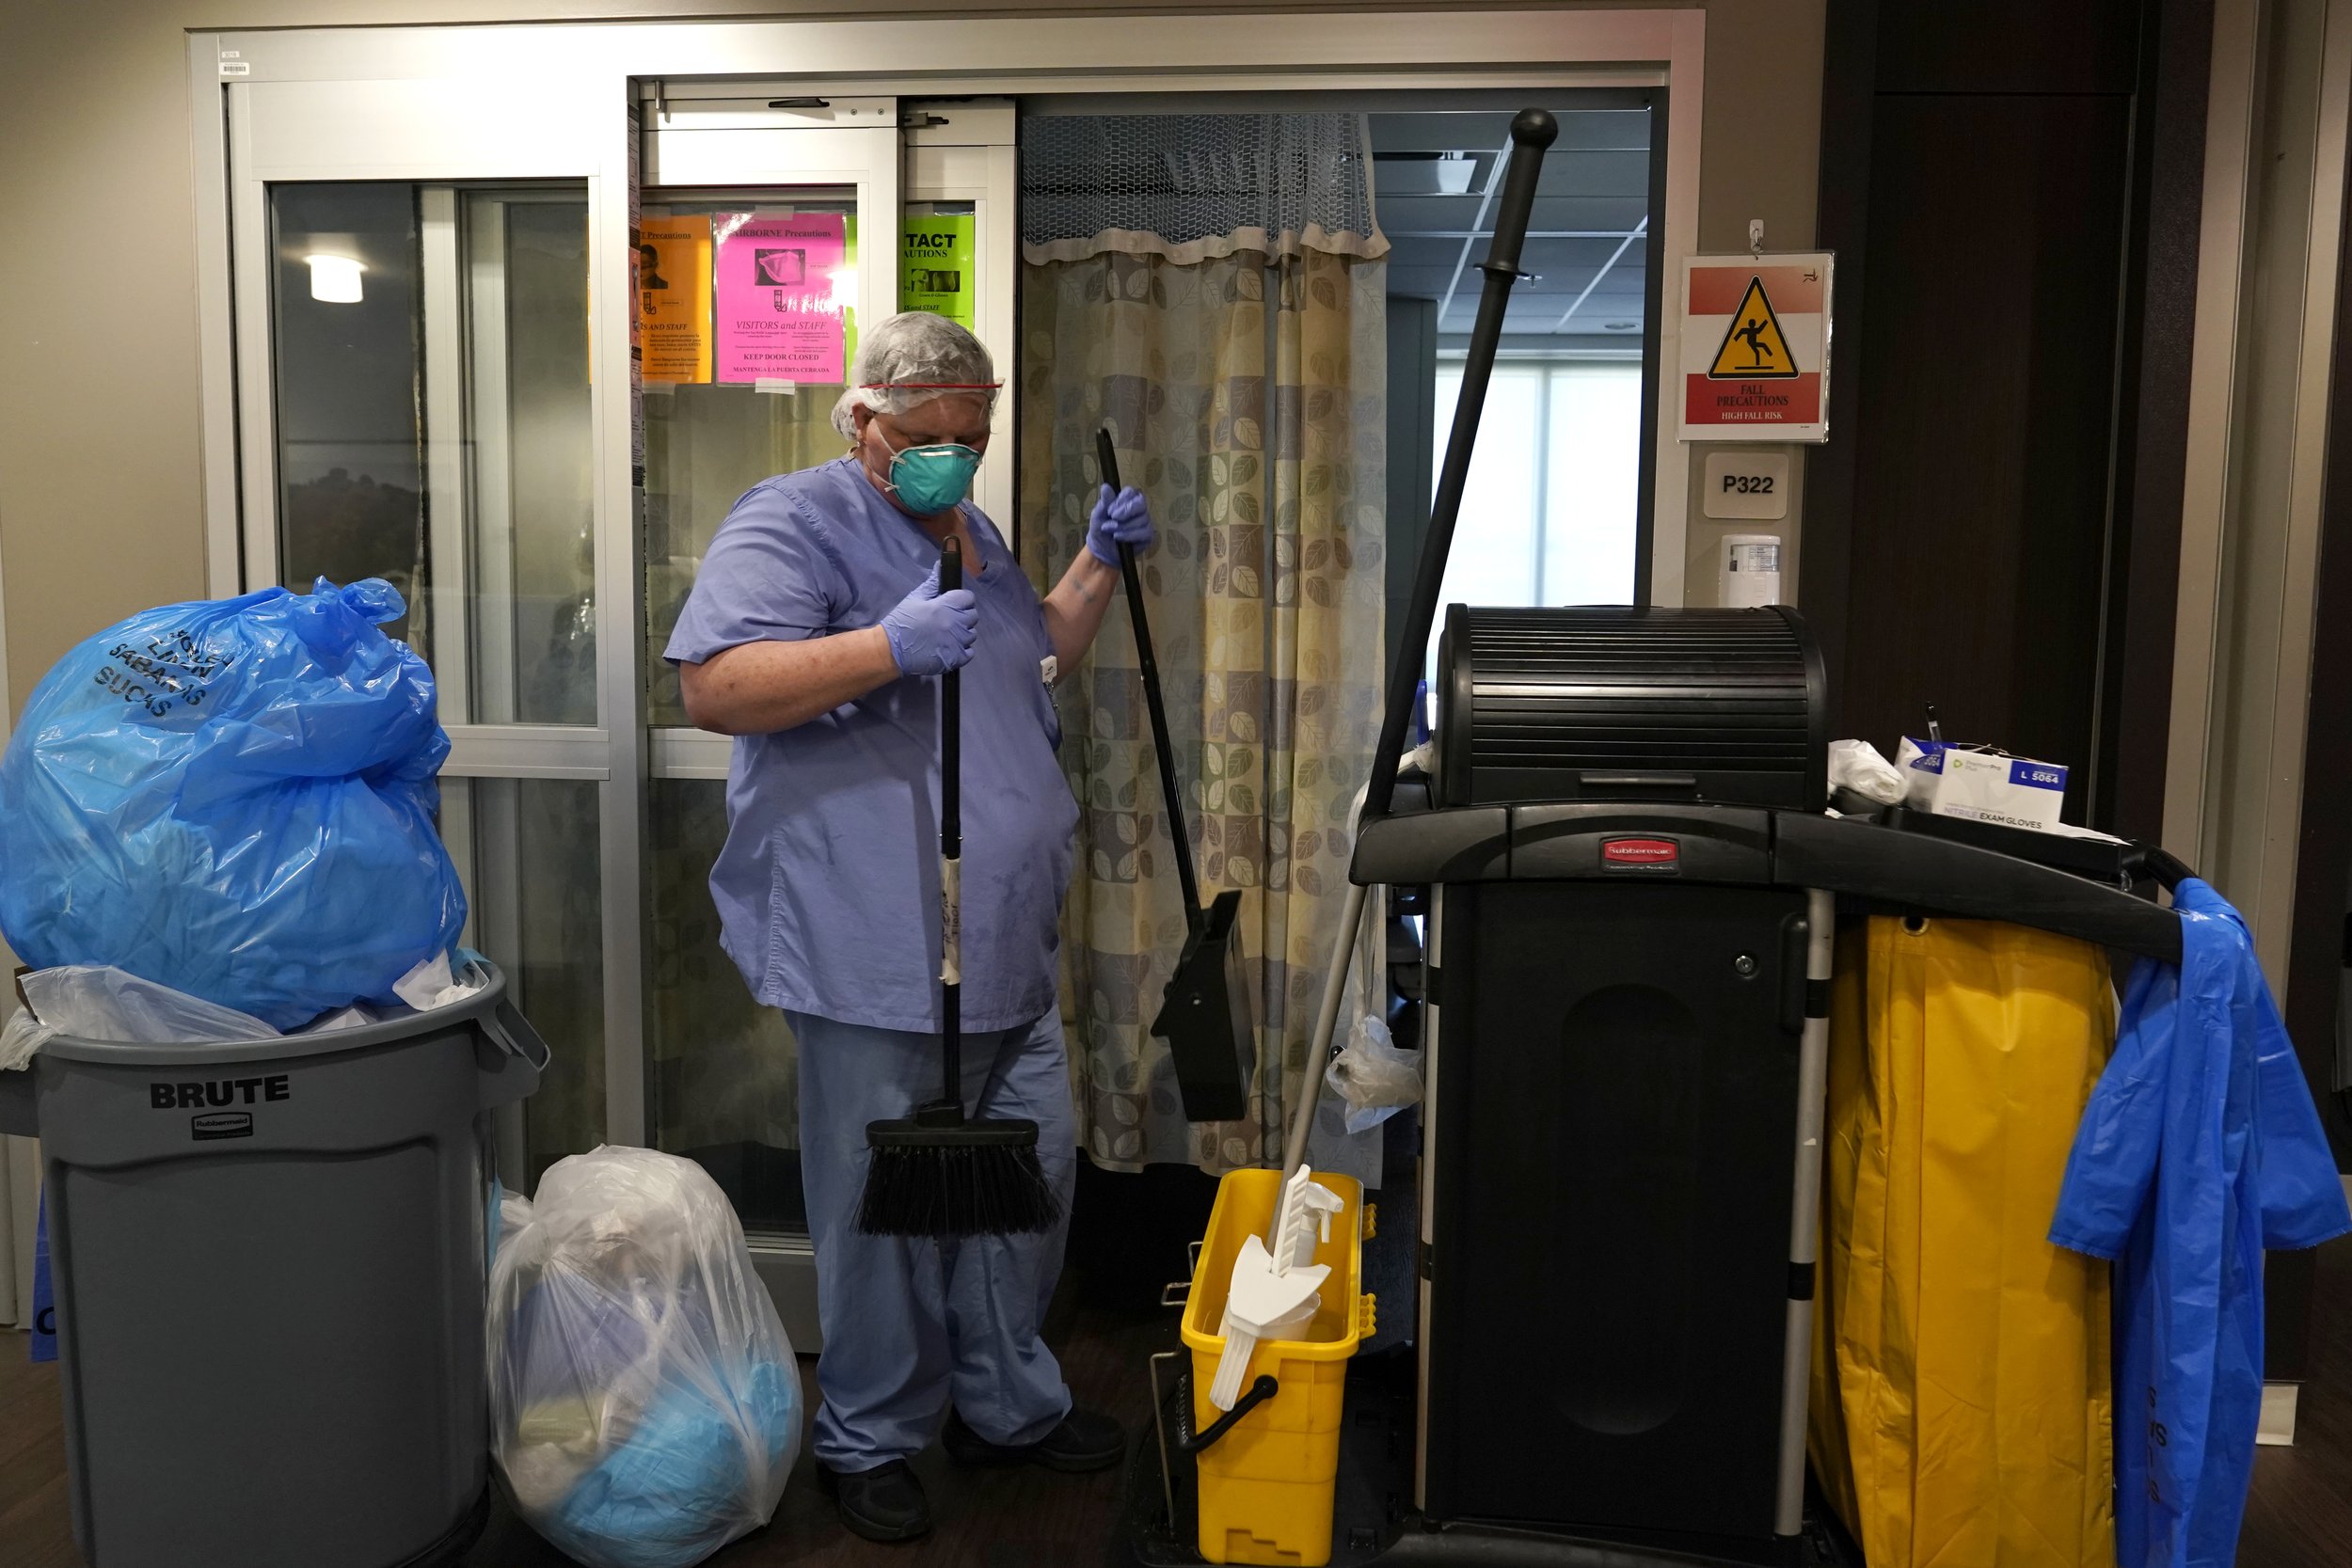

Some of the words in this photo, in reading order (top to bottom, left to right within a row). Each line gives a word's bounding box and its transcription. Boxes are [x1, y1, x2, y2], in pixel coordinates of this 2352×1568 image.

[647, 231, 691, 240] Precautions
[733, 229, 783, 238] AIRBORNE
[785, 229, 832, 238] Precautions
[905, 232, 957, 248] TACT
[736, 320, 779, 330] VISITORS
[780, 321, 796, 330] and
[798, 321, 827, 330] STAFF
[1740, 384, 1765, 395] FALL
[1716, 395, 1789, 406] PRECAUTIONS
[1722, 411, 1743, 420] HIGH
[1744, 411, 1763, 420] FALL
[1764, 410, 1783, 420] RISK
[1723, 475, 1774, 494] P322
[2020, 770, 2028, 780] L
[2031, 771, 2059, 784] 5064
[1979, 812, 2005, 823] EXAM
[2005, 816, 2042, 830] GLOVES
[150, 1074, 291, 1109] BRUTE
[196, 1117, 249, 1128] Rubbermaid
